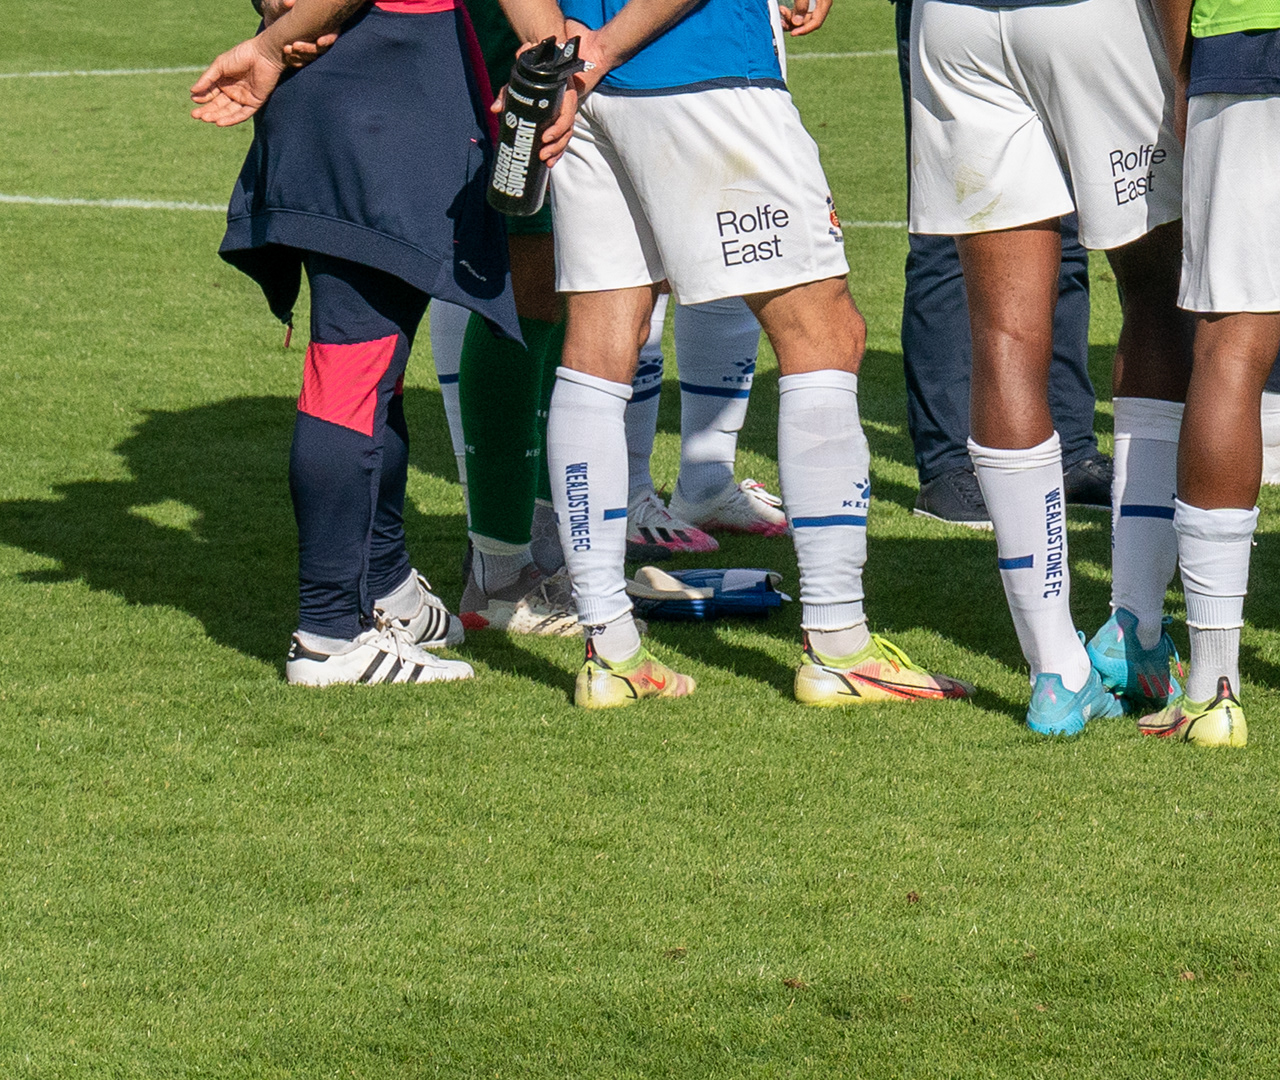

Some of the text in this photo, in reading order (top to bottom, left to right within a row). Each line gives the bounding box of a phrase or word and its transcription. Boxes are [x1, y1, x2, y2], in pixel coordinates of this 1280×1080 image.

[492, 141, 513, 193] SOCCER
[506, 117, 537, 198] SUPPLEMENT
[1109, 144, 1167, 177] Rolfe
[1113, 171, 1155, 206] East
[717, 204, 790, 238] Rolfe
[721, 234, 784, 267] East
[565, 461, 592, 553] WEALDSTONE FC
[1042, 486, 1063, 599] WEALDSTONE FC
